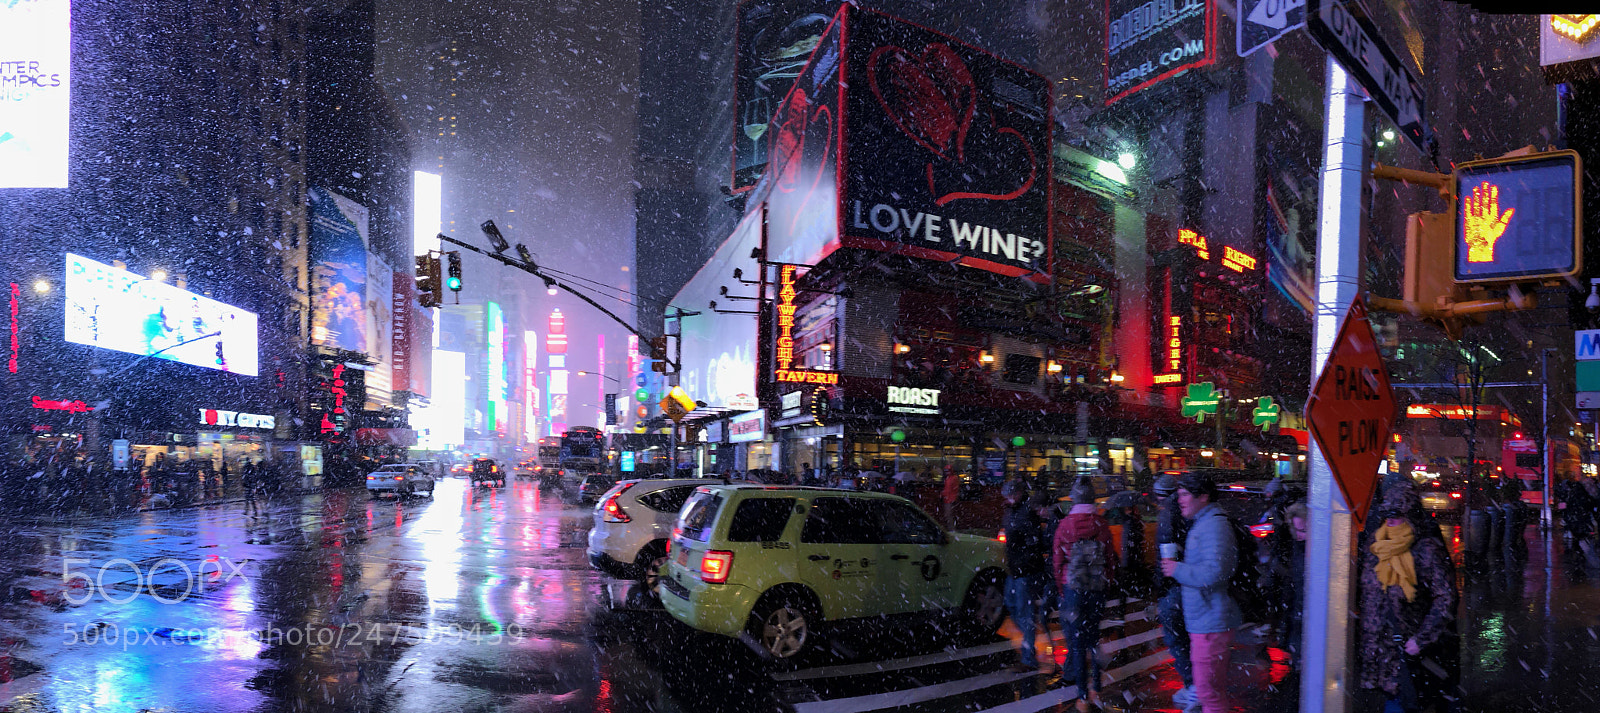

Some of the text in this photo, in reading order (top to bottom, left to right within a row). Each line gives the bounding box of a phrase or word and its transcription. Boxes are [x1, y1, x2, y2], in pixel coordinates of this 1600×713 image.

[1331, 3, 1369, 67] ONE
[0, 61, 40, 73] TER
[853, 200, 1046, 263] LOVE WINE?
[1224, 239, 1256, 270] RIGHT
[776, 264, 797, 369] PLAYWRIGHT
[1169, 316, 1181, 370] RIGHT
[775, 370, 839, 384] TAVERN
[1336, 365, 1380, 400] RAISE
[887, 385, 941, 407] ROAST
[1338, 420, 1380, 457] PLOW
